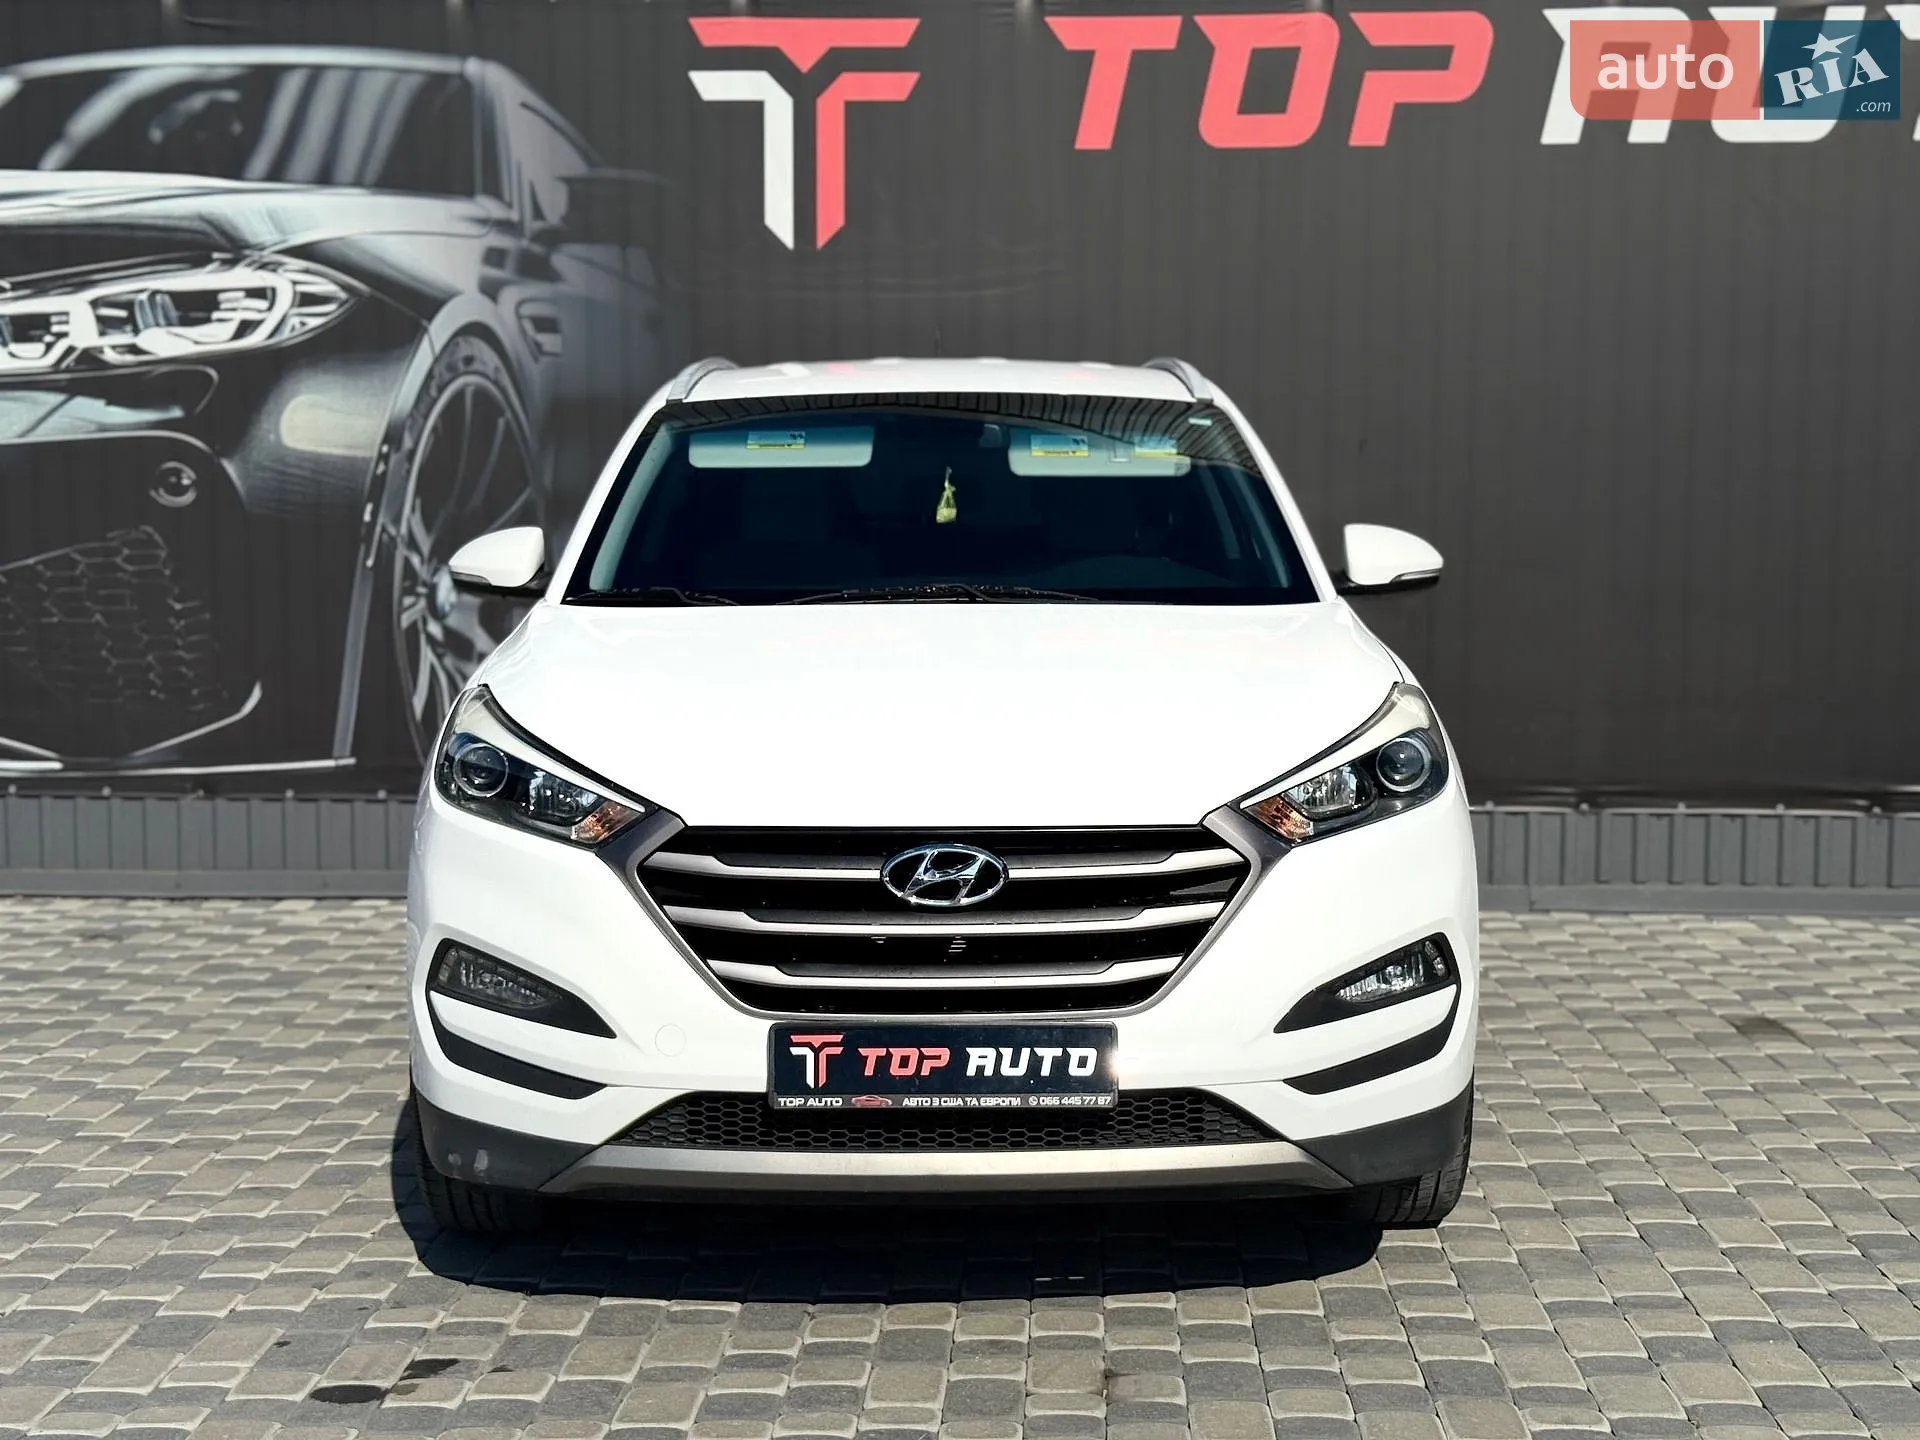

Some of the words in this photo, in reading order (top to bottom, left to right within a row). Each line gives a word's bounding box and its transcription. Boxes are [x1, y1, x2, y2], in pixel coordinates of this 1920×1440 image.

[1044, 11, 1494, 150] TOP
[1540, 5, 1920, 144] AU
[857, 1047, 951, 1077] TOP
[965, 1047, 1098, 1077] AUTO
[778, 1097, 804, 1107] TOP
[806, 1097, 843, 1107] AUTO
[902, 1097, 931, 1107] АВТО
[1061, 1096, 1082, 1106] 445
[1083, 1096, 1096, 1106] 77
